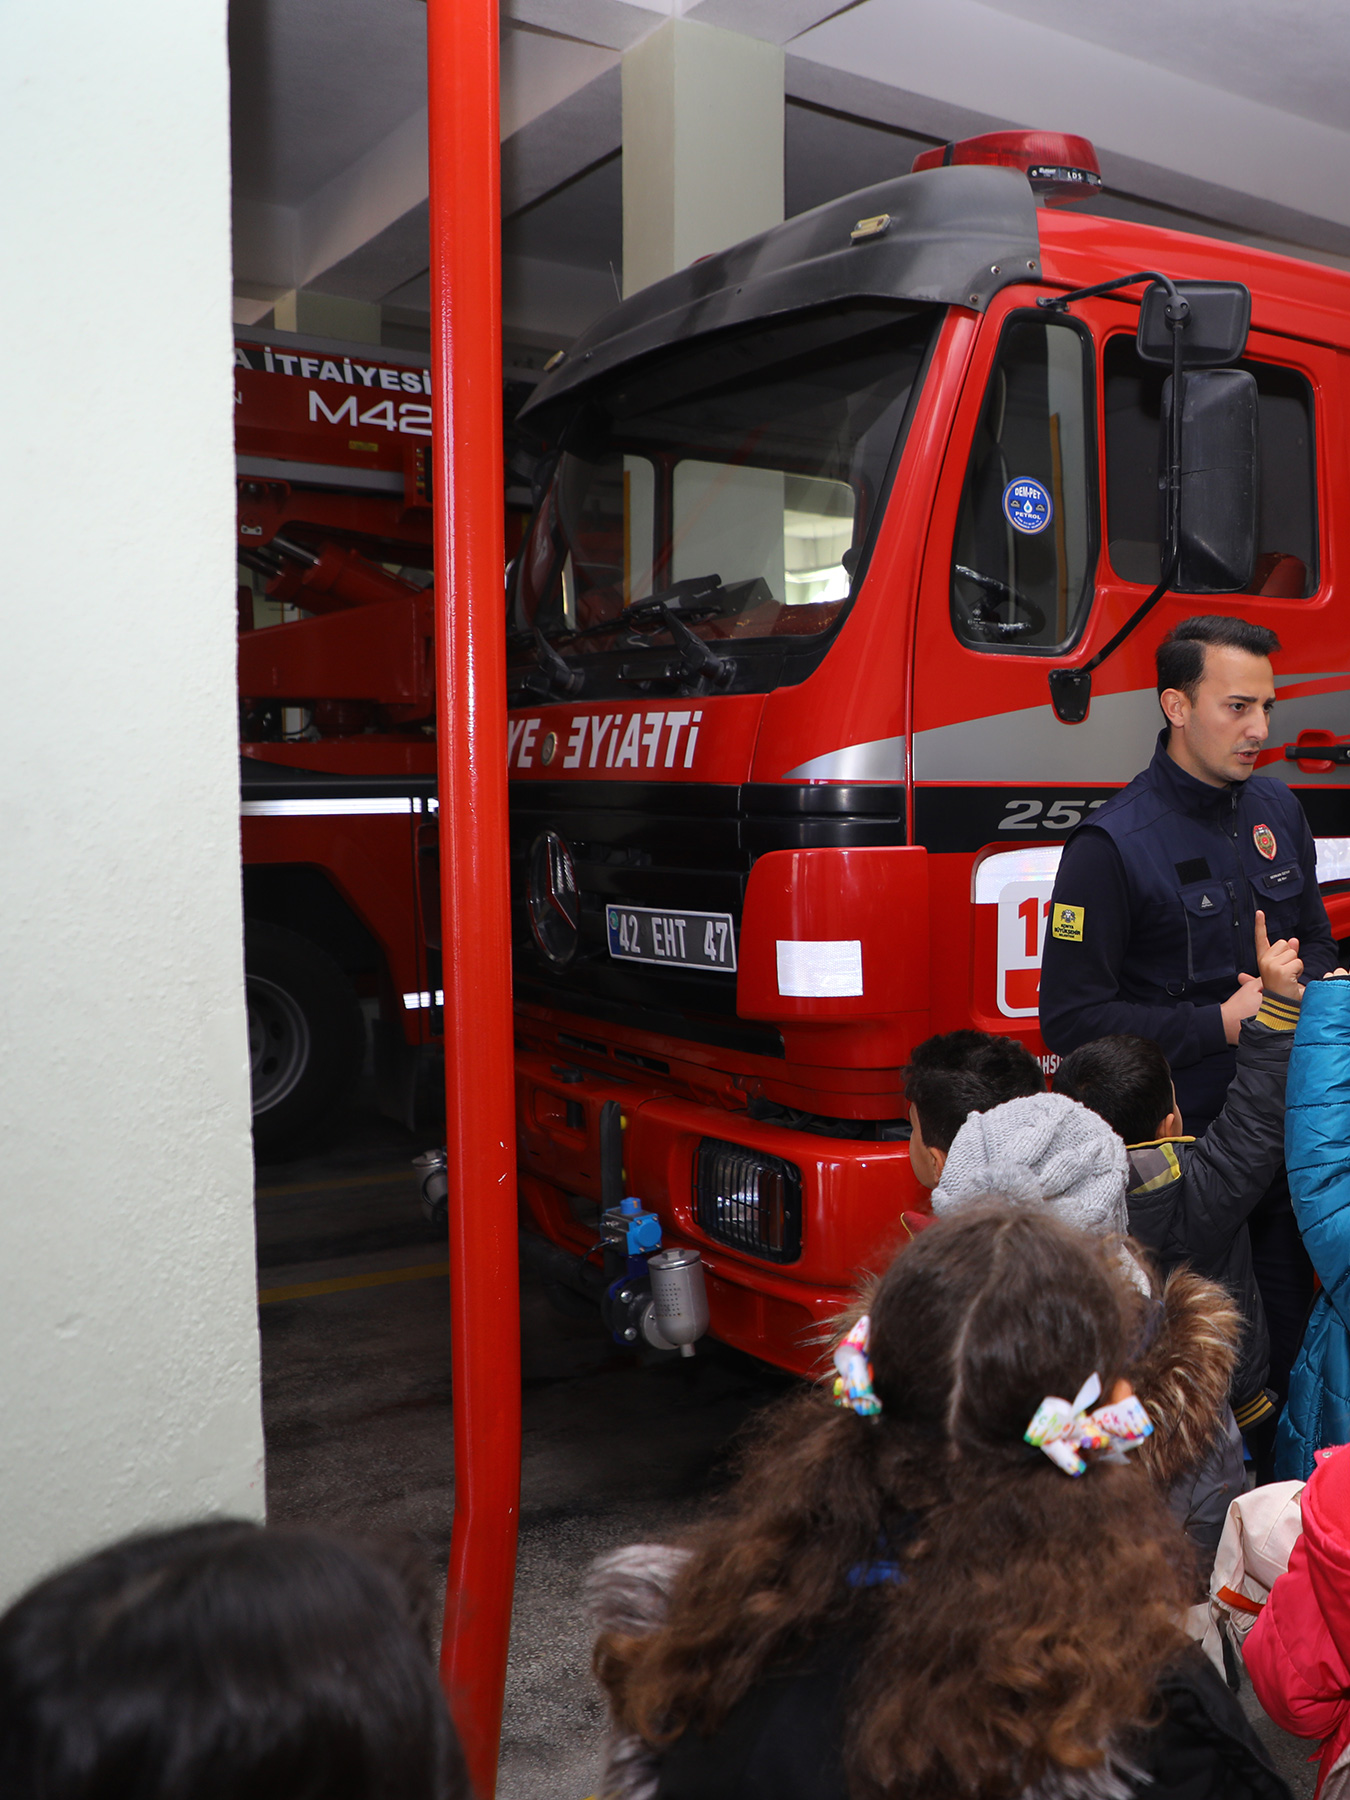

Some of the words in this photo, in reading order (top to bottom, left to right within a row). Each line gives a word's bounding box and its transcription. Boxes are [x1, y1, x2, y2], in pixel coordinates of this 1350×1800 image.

[998, 800, 1108, 830] 25
[619, 914, 641, 953] 42
[651, 917, 686, 959] EHT
[704, 921, 728, 962] 47
